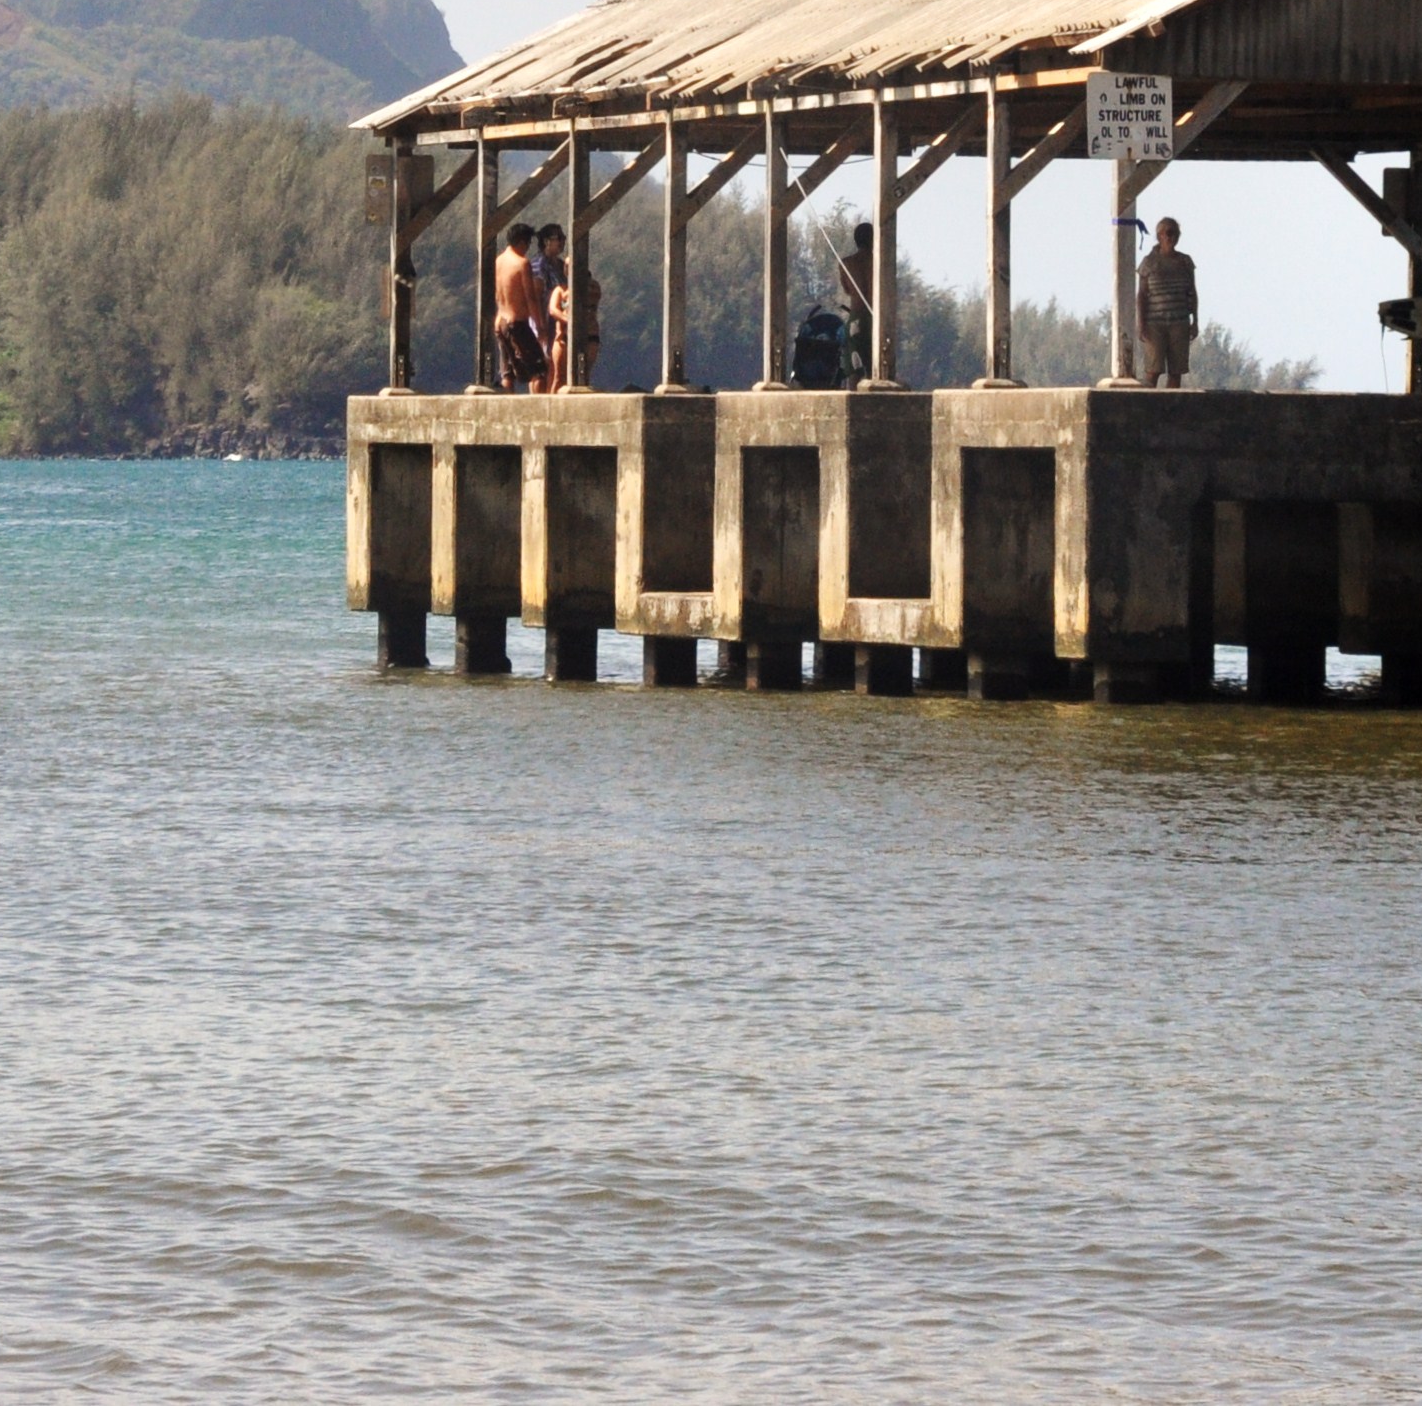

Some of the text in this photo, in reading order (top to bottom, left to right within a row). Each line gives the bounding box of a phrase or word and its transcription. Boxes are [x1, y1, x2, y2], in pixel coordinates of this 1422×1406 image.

[1151, 93, 1166, 105] ON
[1098, 109, 1162, 122] STRUCTURE
[1146, 126, 1169, 139] WILL
